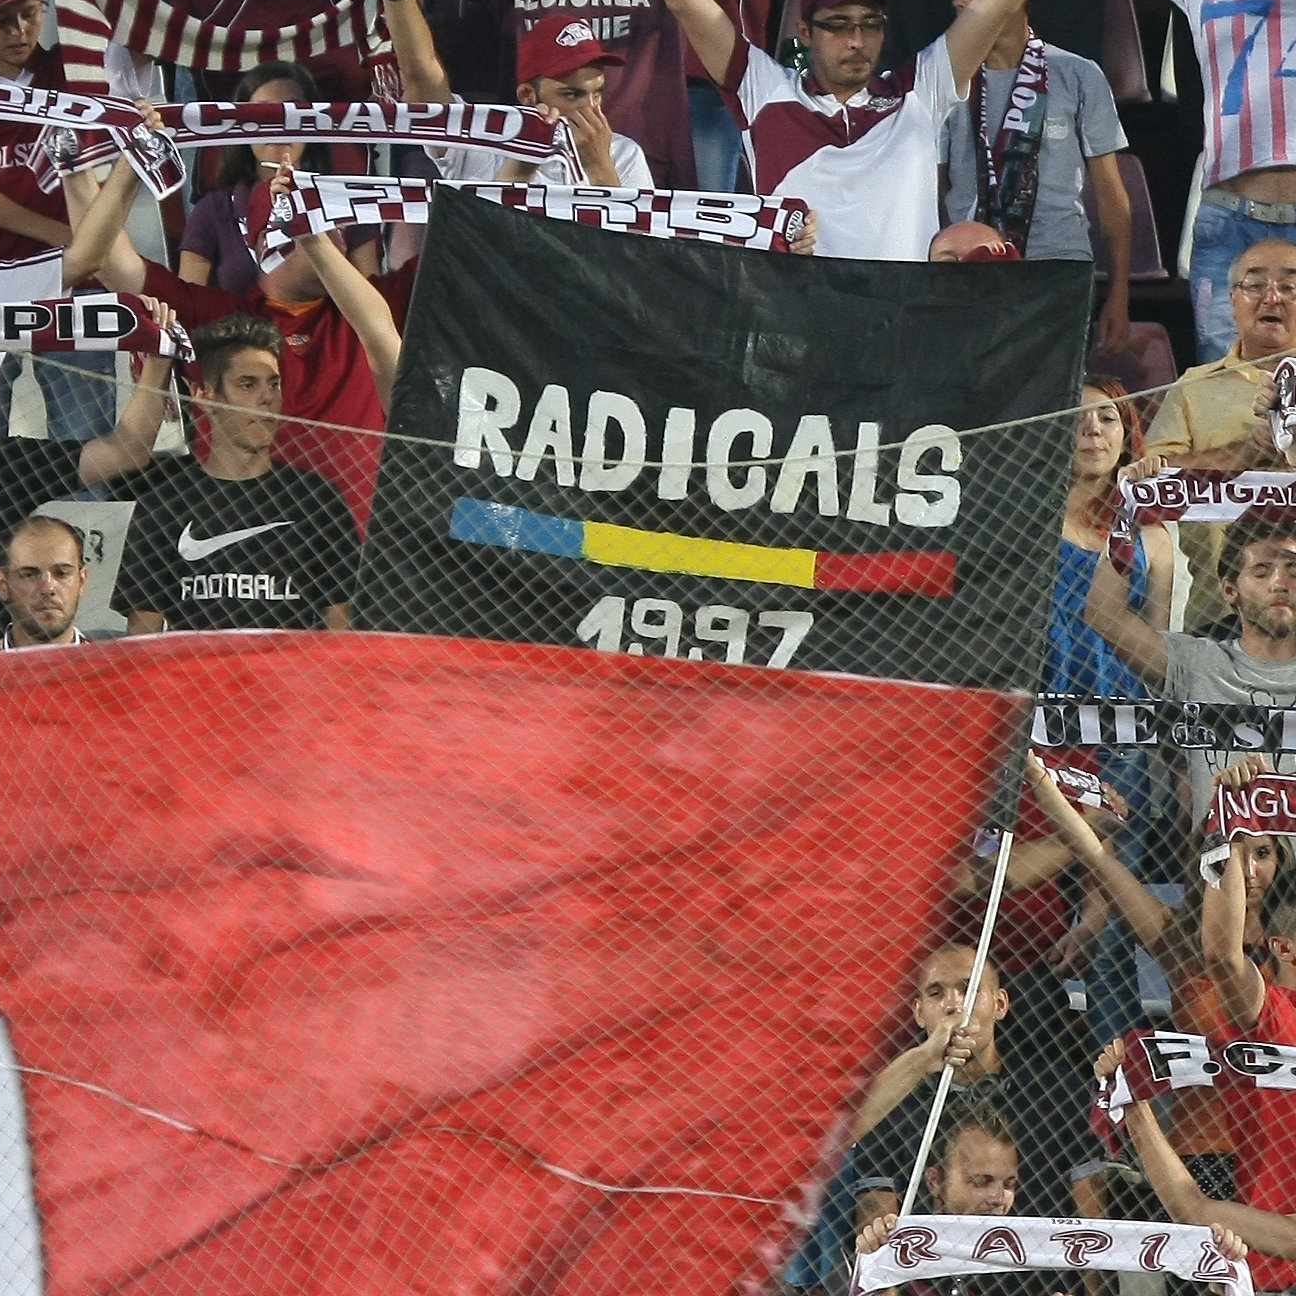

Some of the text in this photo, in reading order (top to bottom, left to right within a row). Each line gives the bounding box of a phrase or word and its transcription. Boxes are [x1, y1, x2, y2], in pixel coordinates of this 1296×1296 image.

[454, 366, 961, 528] RADICALS
[179, 575, 301, 602] FOOTBALL
[576, 595, 816, 670] 1997
